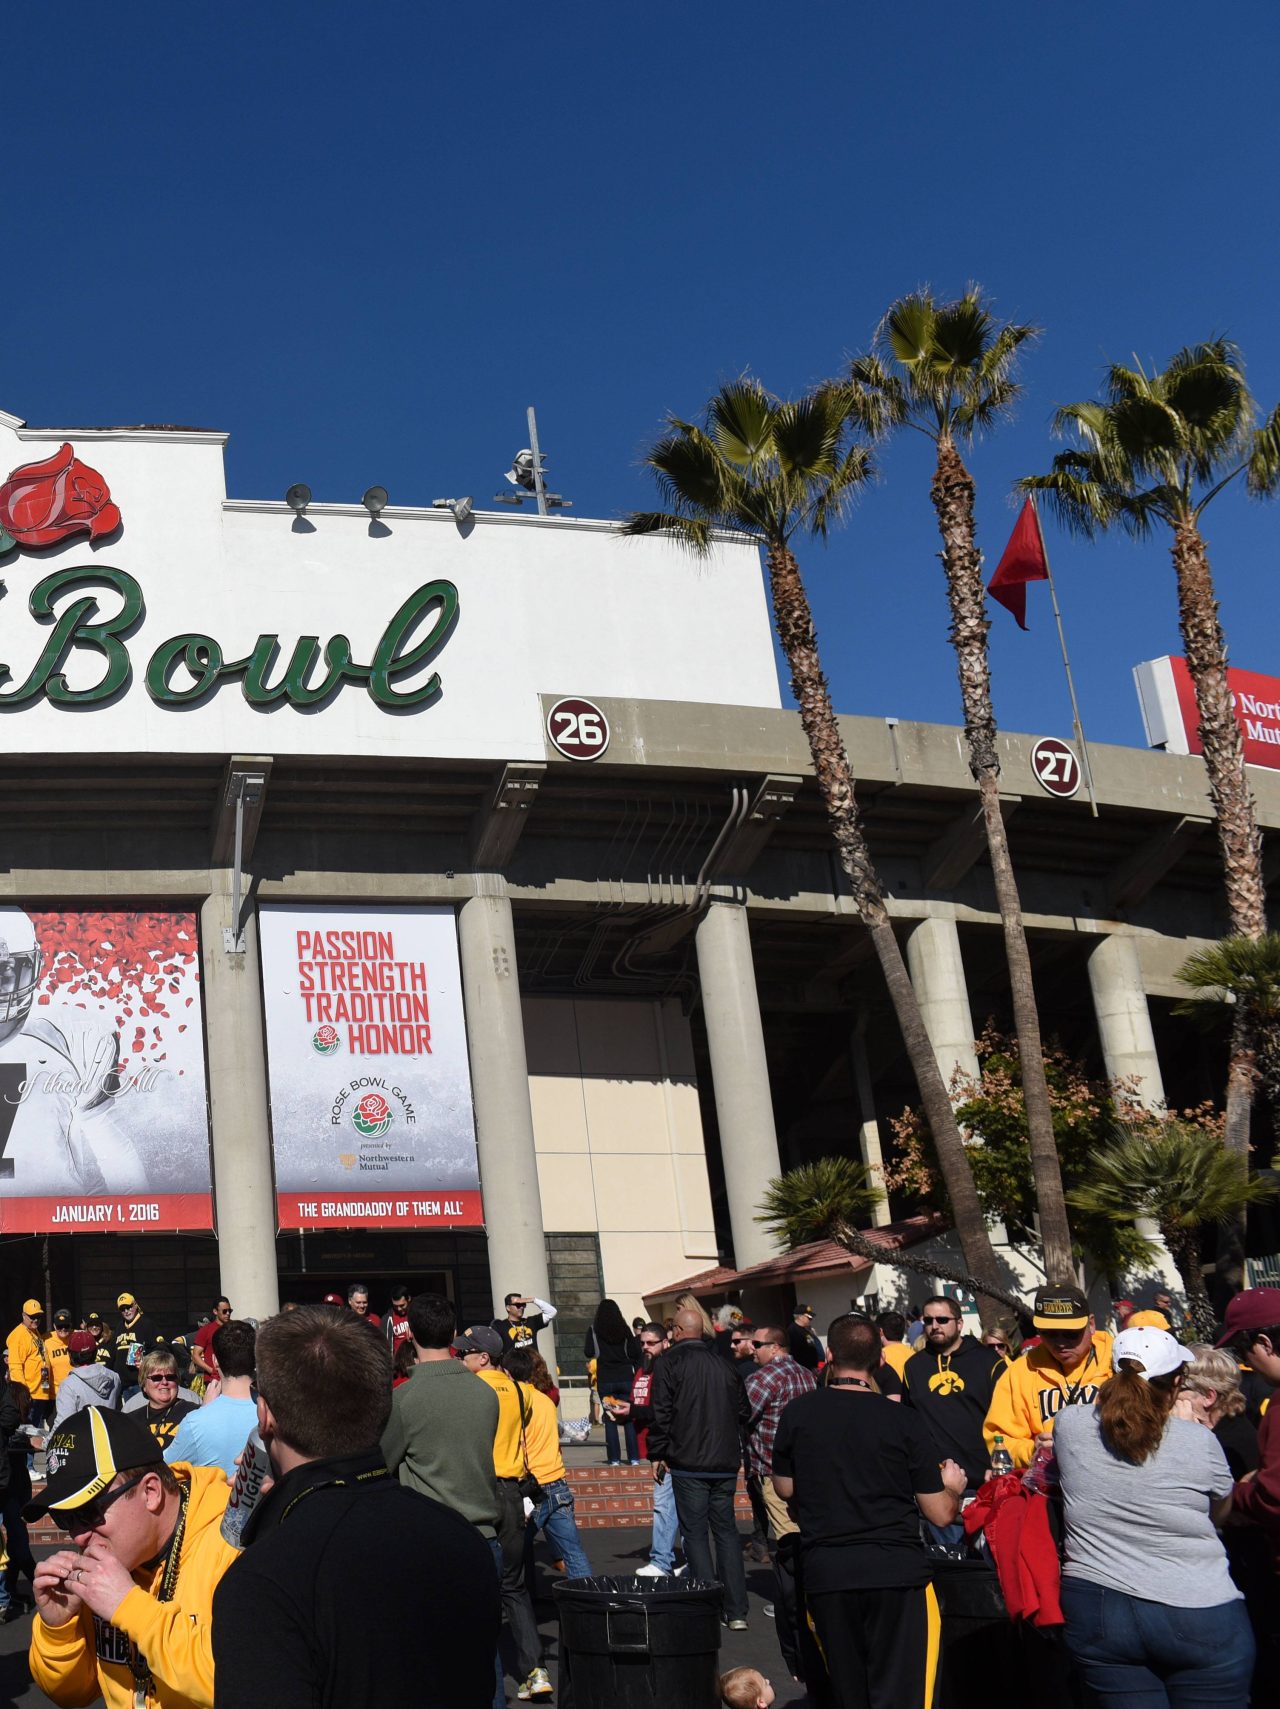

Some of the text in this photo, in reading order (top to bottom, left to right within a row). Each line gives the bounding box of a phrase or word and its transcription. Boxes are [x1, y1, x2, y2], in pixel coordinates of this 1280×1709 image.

[554, 711, 603, 745] 26
[1037, 751, 1073, 783] 27
[296, 930, 394, 961] PASSION
[298, 961, 427, 991] STRENGTH
[300, 992, 430, 1023] TRADITION
[348, 1023, 433, 1055] HONOR
[4, 1067, 172, 1104] of them All
[331, 1076, 416, 1125] ROSE BOWL GAME
[359, 1154, 415, 1162] Northwestern
[359, 1163, 389, 1171] Mutual
[51, 1204, 160, 1223] JANUARY 1, 2016
[297, 1200, 463, 1217] THE GRANDDADDY OF THEM ALL
[1038, 1384, 1099, 1422] IOW
[241, 1461, 265, 1510] LIGHT
